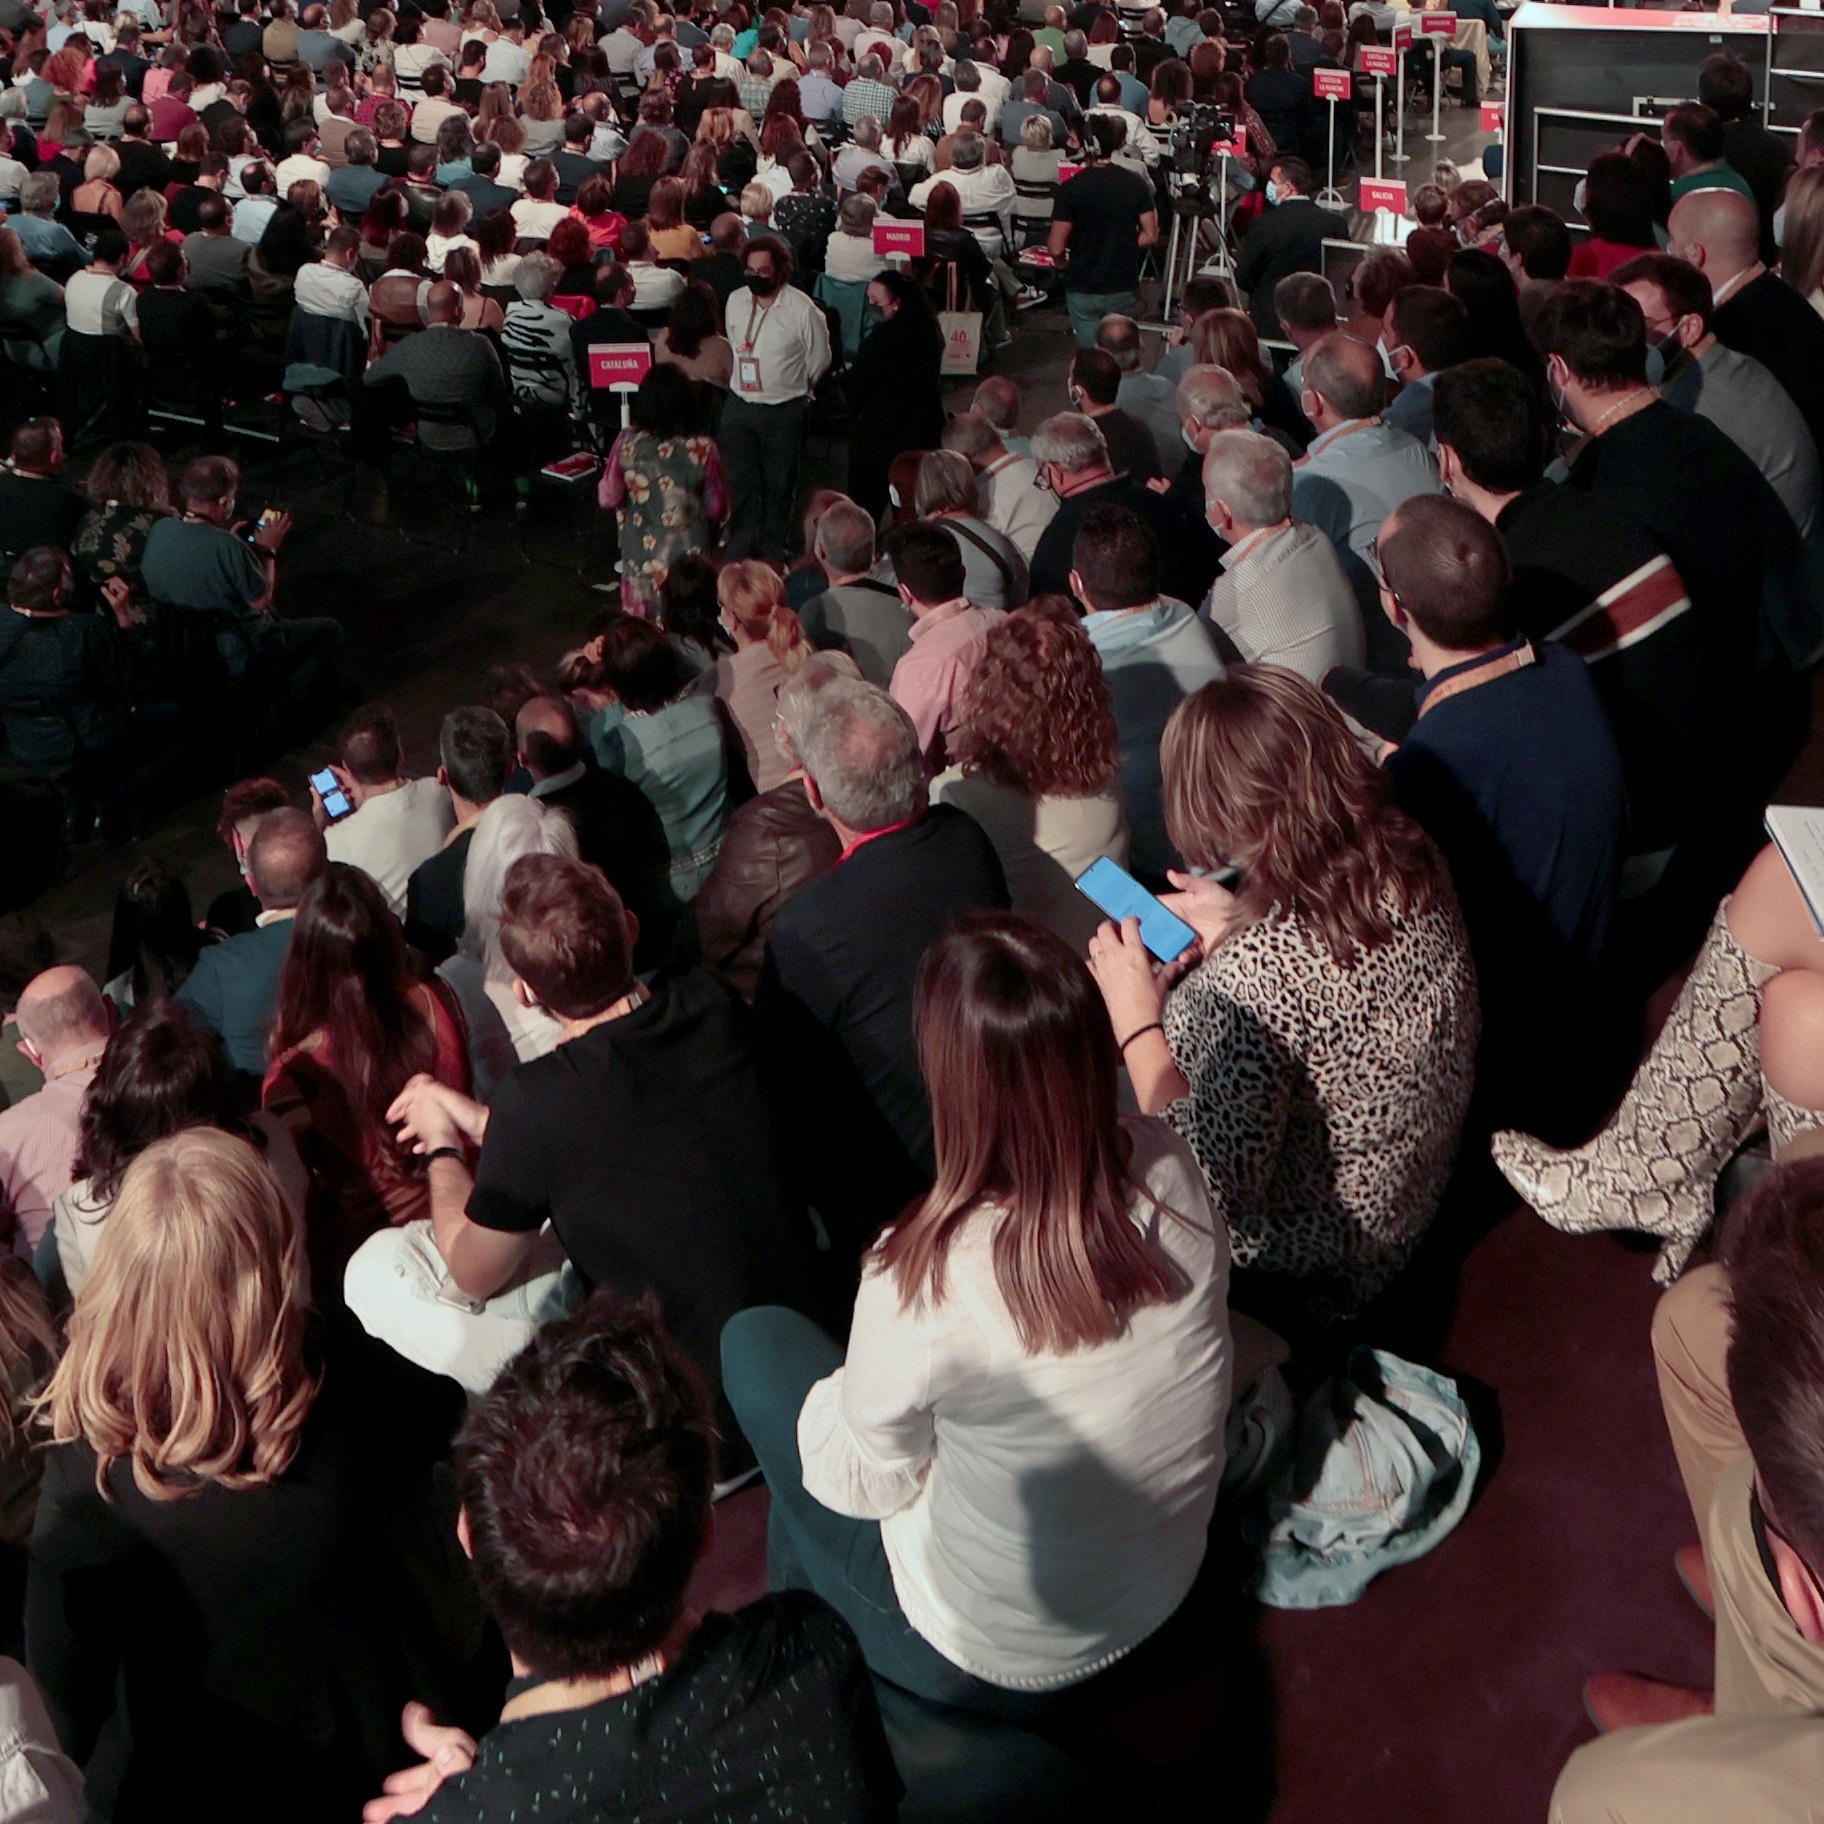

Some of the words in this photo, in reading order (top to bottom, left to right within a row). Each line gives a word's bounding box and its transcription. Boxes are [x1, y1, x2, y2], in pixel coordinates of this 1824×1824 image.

[1371, 191, 1394, 201] GALICIA
[886, 232, 911, 241] MADRID
[600, 357, 639, 370] CATALUÑA
